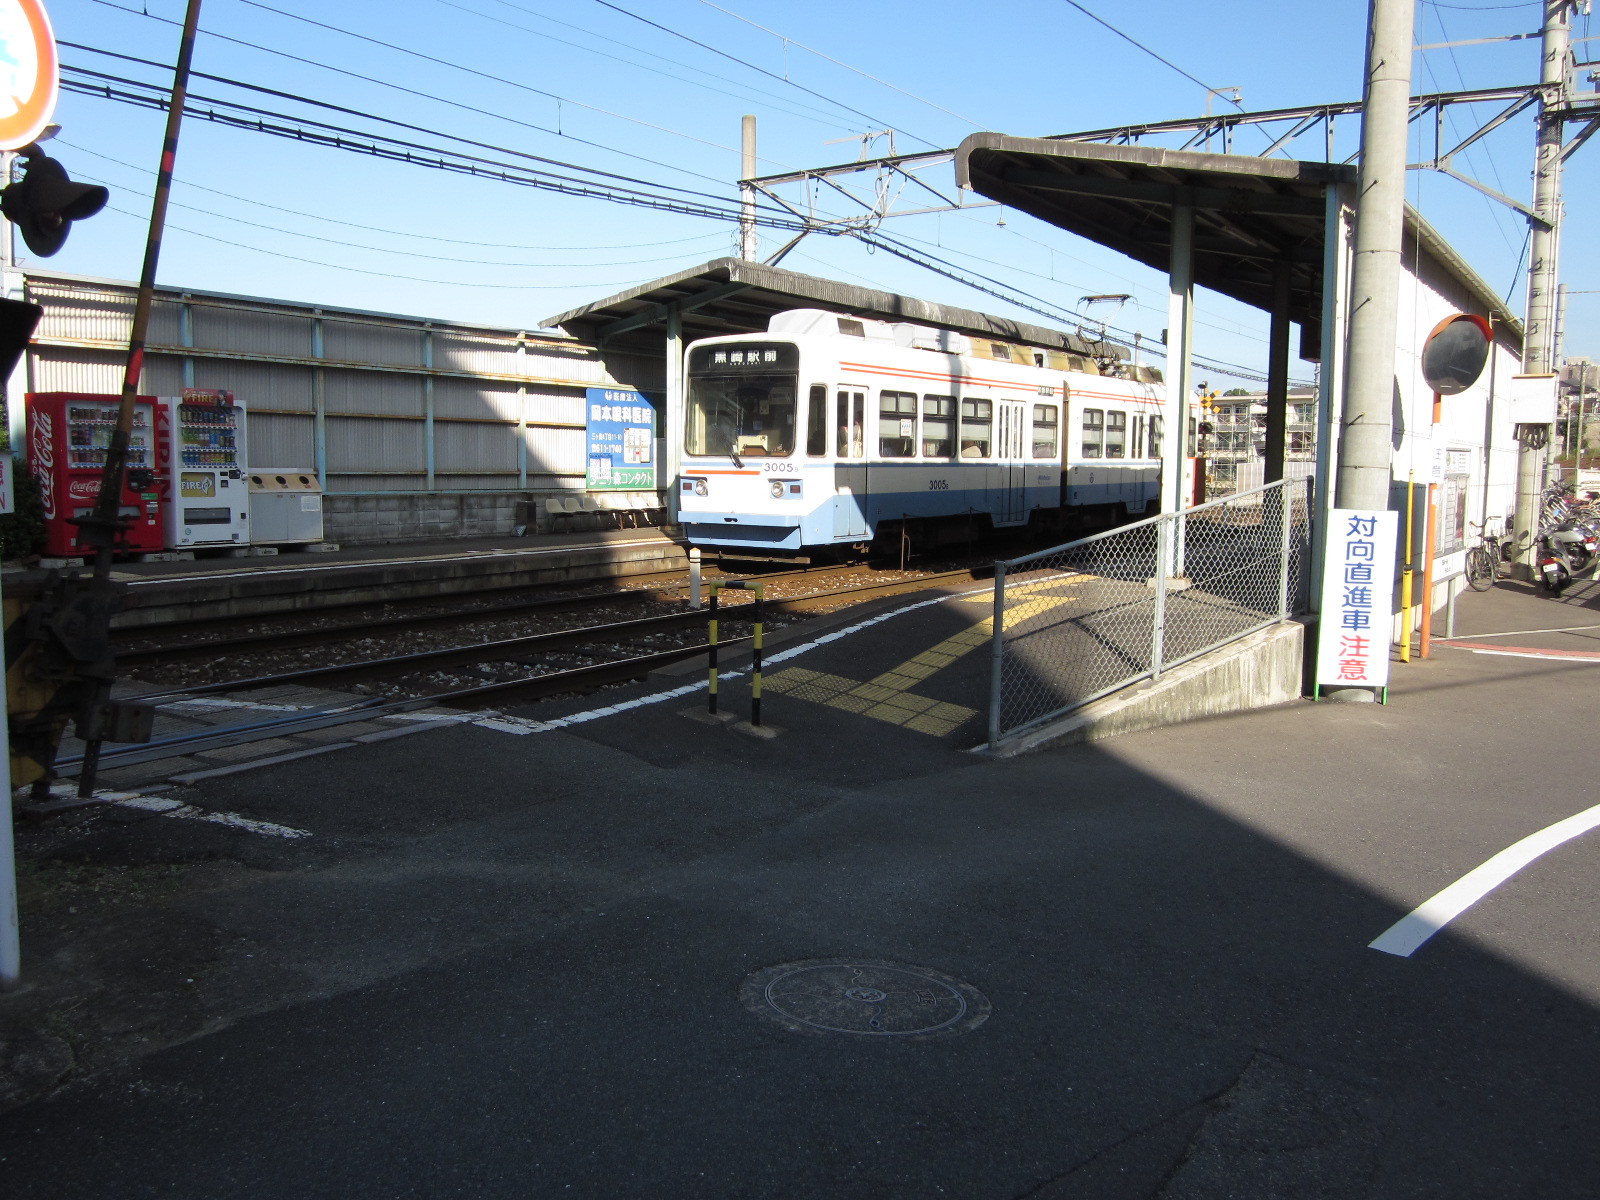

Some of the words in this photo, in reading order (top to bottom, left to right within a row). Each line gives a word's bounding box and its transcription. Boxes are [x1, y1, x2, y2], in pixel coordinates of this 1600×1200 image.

[714, 350, 777, 364] 黒崎駅前
[192, 393, 214, 403] FIRE
[613, 391, 638, 402] 医療法人
[591, 404, 652, 424] 岡本眼科医院
[181, 481, 202, 490] FIRE
[1337, 515, 1378, 680] 対向直進車注意
